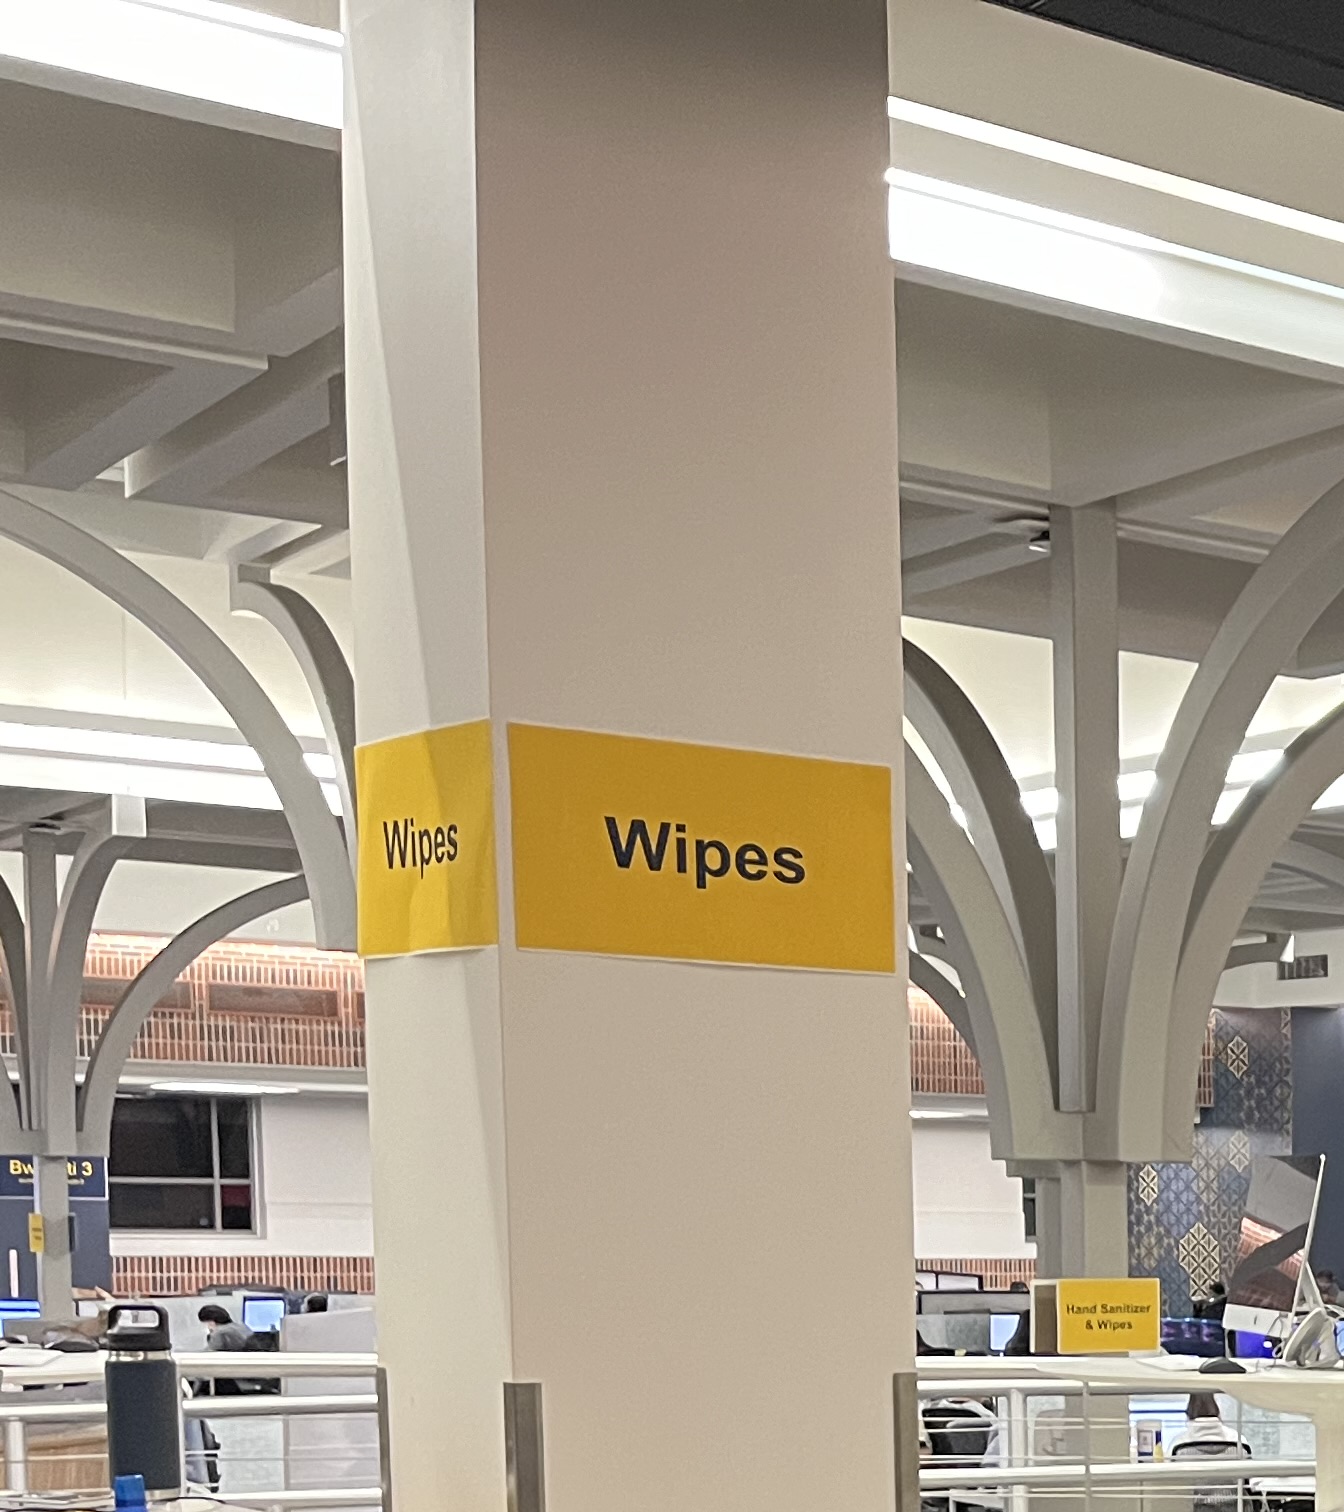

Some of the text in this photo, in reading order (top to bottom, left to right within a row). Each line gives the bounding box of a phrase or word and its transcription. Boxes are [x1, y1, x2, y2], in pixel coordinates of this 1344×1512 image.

[383, 817, 459, 880] Wipes
[604, 815, 807, 890] Wipes
[81, 1161, 93, 1177] 3
[1066, 1303, 1151, 1315] Hand Sanitizer
[1085, 1319, 1133, 1331] & Wipes
